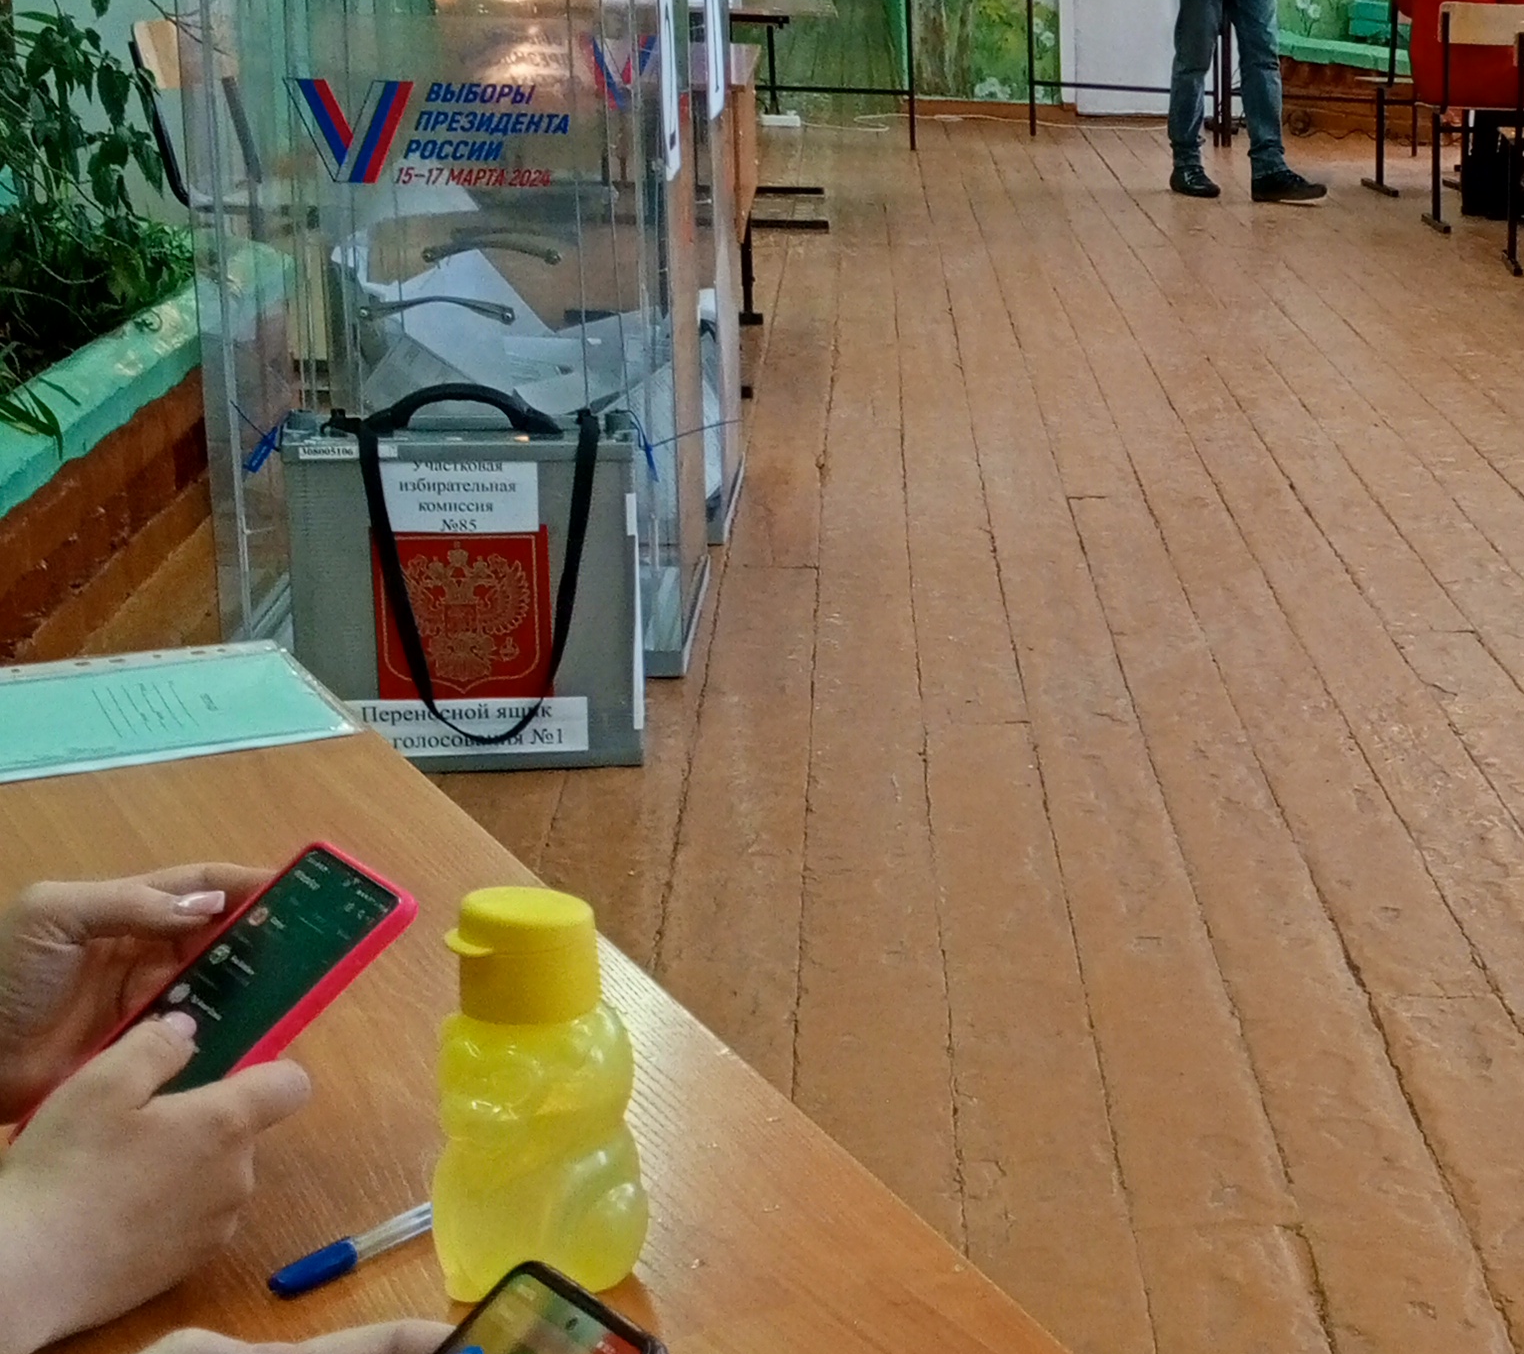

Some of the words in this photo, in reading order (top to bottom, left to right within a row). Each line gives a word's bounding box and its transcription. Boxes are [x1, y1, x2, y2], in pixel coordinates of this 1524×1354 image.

[425, 82, 536, 105] ВЫБОРЫ
[414, 111, 570, 135] ПРЕЗИДЕНТА
[403, 139, 503, 161] РОССИИ
[445, 168, 506, 187] МАРТА
[508, 167, 551, 187] 2024
[413, 461, 503, 472] Участковая
[399, 478, 516, 495] избирательная
[418, 502, 493, 513] комиссия
[440, 519, 477, 532] №85
[361, 703, 490, 726] Переносной
[530, 728, 563, 745] №1
